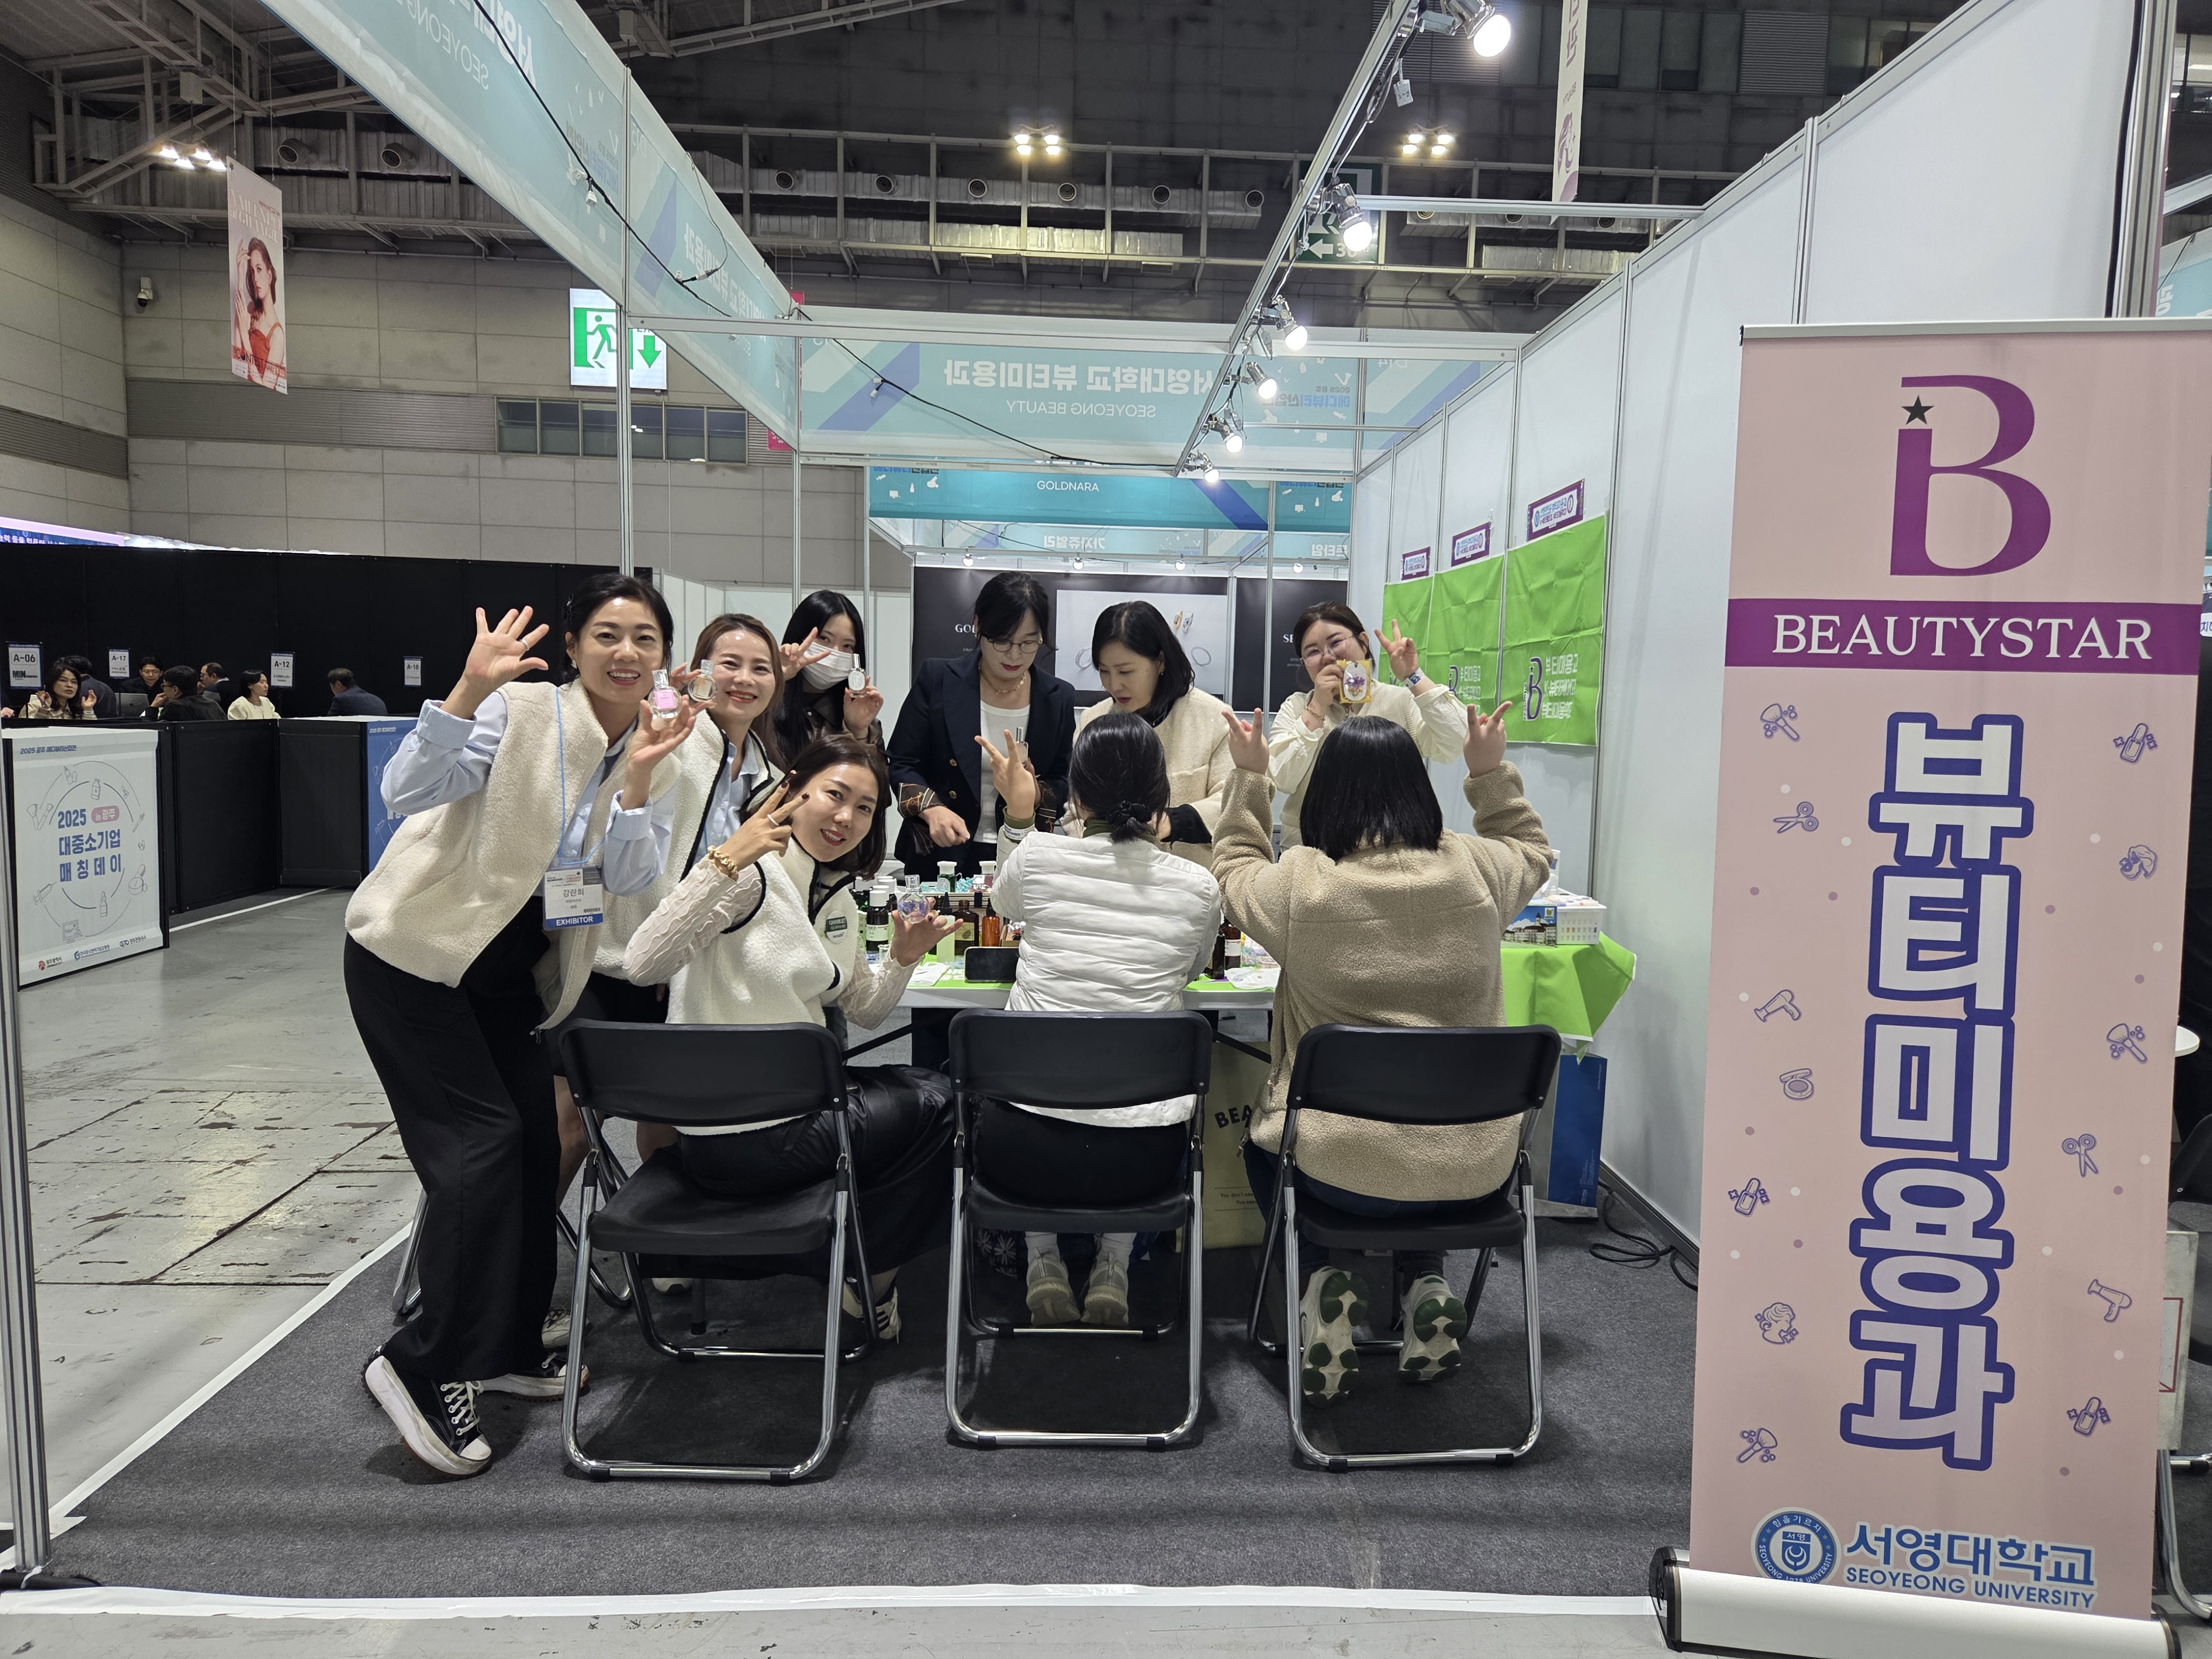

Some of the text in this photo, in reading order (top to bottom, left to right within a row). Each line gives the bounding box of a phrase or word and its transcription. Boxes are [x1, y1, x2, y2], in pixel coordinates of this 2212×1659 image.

[1037, 481, 1099, 492] GOLDNARA
[1772, 614, 2152, 660] BEAUTYSTAR
[13, 654, 35, 662] A-06
[58, 808, 116, 829] 2025 in 광주
[59, 829, 121, 855] 대중소기업
[556, 916, 593, 926] EXHIBITOR
[1840, 712, 2033, 1471] 뷰티미용과
[1787, 1532, 1806, 1541] 서영
[1759, 1545, 1783, 1579] SEOYEONG
[1806, 1552, 1833, 1583] UNIVERSITY
[1848, 1525, 2096, 1586] 서영대학교
[1846, 1567, 2095, 1609] SEOYEONG UNIVERSITY
